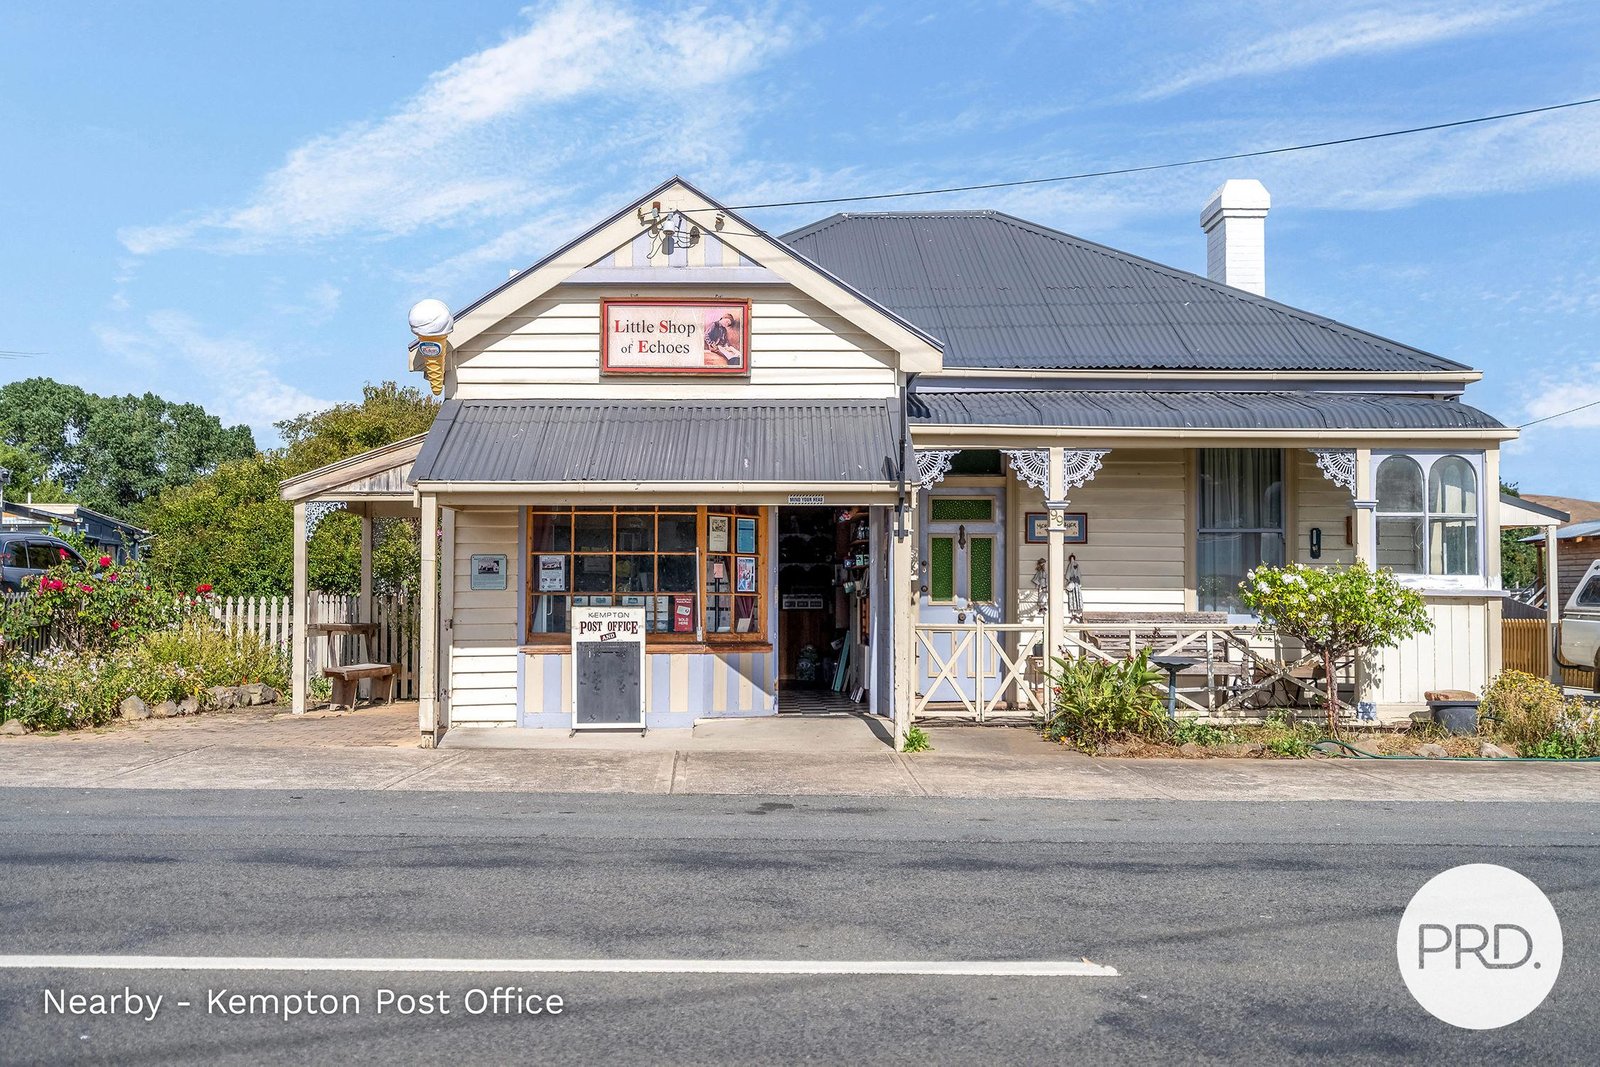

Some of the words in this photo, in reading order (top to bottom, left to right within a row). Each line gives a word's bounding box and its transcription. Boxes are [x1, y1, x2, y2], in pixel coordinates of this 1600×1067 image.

[614, 319, 655, 334] Little
[659, 319, 696, 338] Shop
[620, 343, 634, 354] of
[637, 340, 690, 354] Echoes
[588, 611, 630, 619] KEMPTON
[579, 621, 602, 635] POST
[607, 621, 638, 635] OFFICE
[602, 633, 616, 641] AND
